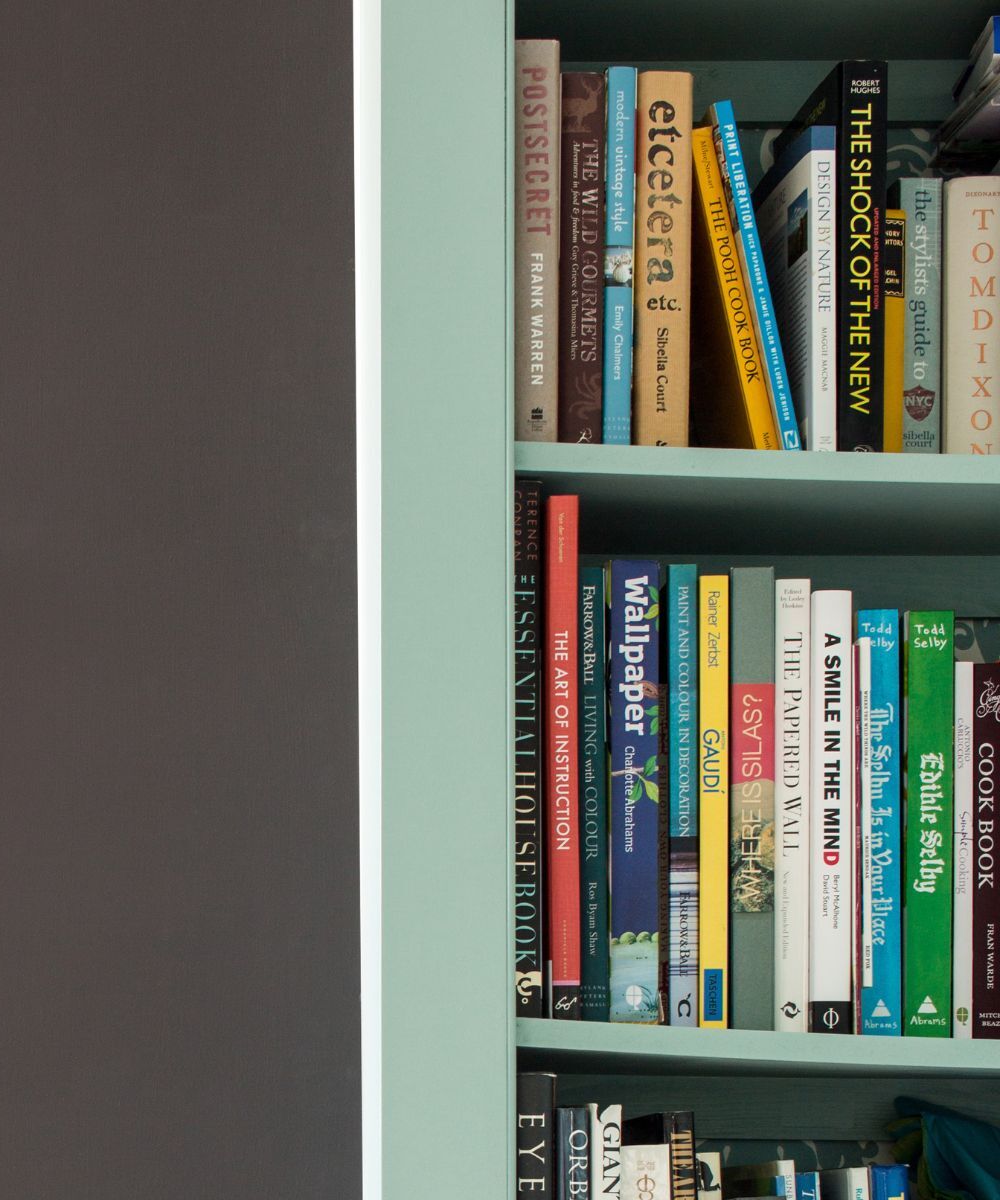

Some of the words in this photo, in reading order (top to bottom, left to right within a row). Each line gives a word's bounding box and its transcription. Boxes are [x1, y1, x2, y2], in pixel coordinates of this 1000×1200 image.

[850, 87, 880, 95] HUGHES
[616, 91, 630, 141] modern
[850, 103, 872, 155] THE
[522, 66, 552, 236] POSTSECRET
[581, 139, 598, 181] THE
[723, 124, 739, 160] PRINT
[612, 147, 628, 198] vintage
[646, 100, 682, 287] etcetera
[730, 163, 754, 229] LIBERATION
[817, 161, 831, 222] DESIGN
[580, 189, 599, 245] WILD
[611, 203, 627, 232] style
[709, 198, 726, 233] THE
[849, 159, 872, 252] SHOCK
[914, 190, 931, 222] the
[818, 226, 830, 246] BY
[530, 253, 543, 309] FRANK
[717, 237, 738, 284] POOH
[818, 249, 832, 312] NATURE
[849, 255, 871, 291] OF
[580, 250, 598, 362] GOURMETS
[612, 305, 625, 330] Emily
[646, 294, 682, 312] etc.
[729, 287, 749, 336] COOK
[849, 296, 871, 344] THE
[531, 315, 544, 385] WARREN
[656, 328, 669, 370] Sibella
[909, 300, 932, 357] guide
[613, 334, 624, 380] Chalmers
[739, 337, 760, 384] BOOK
[913, 361, 930, 379] to
[656, 375, 668, 412] Court
[850, 352, 871, 414] NEW
[904, 397, 933, 406] NYC
[903, 430, 935, 439] sibella
[678, 586, 689, 625] PAINT
[708, 591, 720, 626] Rainer
[555, 631, 568, 660] THE
[679, 629, 689, 659] AND
[708, 632, 720, 667] Zerbst
[824, 633, 840, 647] A
[914, 625, 945, 636] Todd
[914, 638, 947, 651] Selby
[619, 576, 649, 736] Wallpaper
[783, 632, 802, 679] THE
[555, 667, 567, 701] ART
[678, 662, 689, 721] COLOUR
[824, 655, 840, 722] SMILE
[555, 705, 568, 727] OF
[584, 696, 597, 755] LIVING
[679, 728, 689, 742] IN
[742, 694, 762, 776] SILAS?
[783, 687, 802, 788] PAPERED
[702, 729, 725, 794] GAUDÍ
[824, 730, 840, 752] IN
[555, 734, 570, 850] INSTRUCTION
[584, 760, 594, 782] with
[625, 746, 636, 796] Charlotte
[678, 748, 690, 837] DECORATION
[742, 783, 761, 805] IS
[824, 760, 840, 799] THE
[978, 743, 994, 812] COOK
[585, 786, 597, 860] COLOUR
[625, 799, 635, 852] Abrahams
[783, 796, 802, 857] WALL
[824, 808, 840, 865] MIND
[740, 808, 761, 900] WHERE
[913, 830, 945, 893] Selby
[956, 848, 968, 894] Cooking
[979, 820, 993, 888] BOOK
[589, 882, 597, 900] Ros
[588, 903, 598, 928] Byam
[589, 932, 598, 955] Shaw
[709, 974, 717, 1015] TASCHEN
[910, 1016, 946, 1026] Abrams
[518, 1113, 545, 1193] EYE
[670, 1130, 691, 1170] THE
